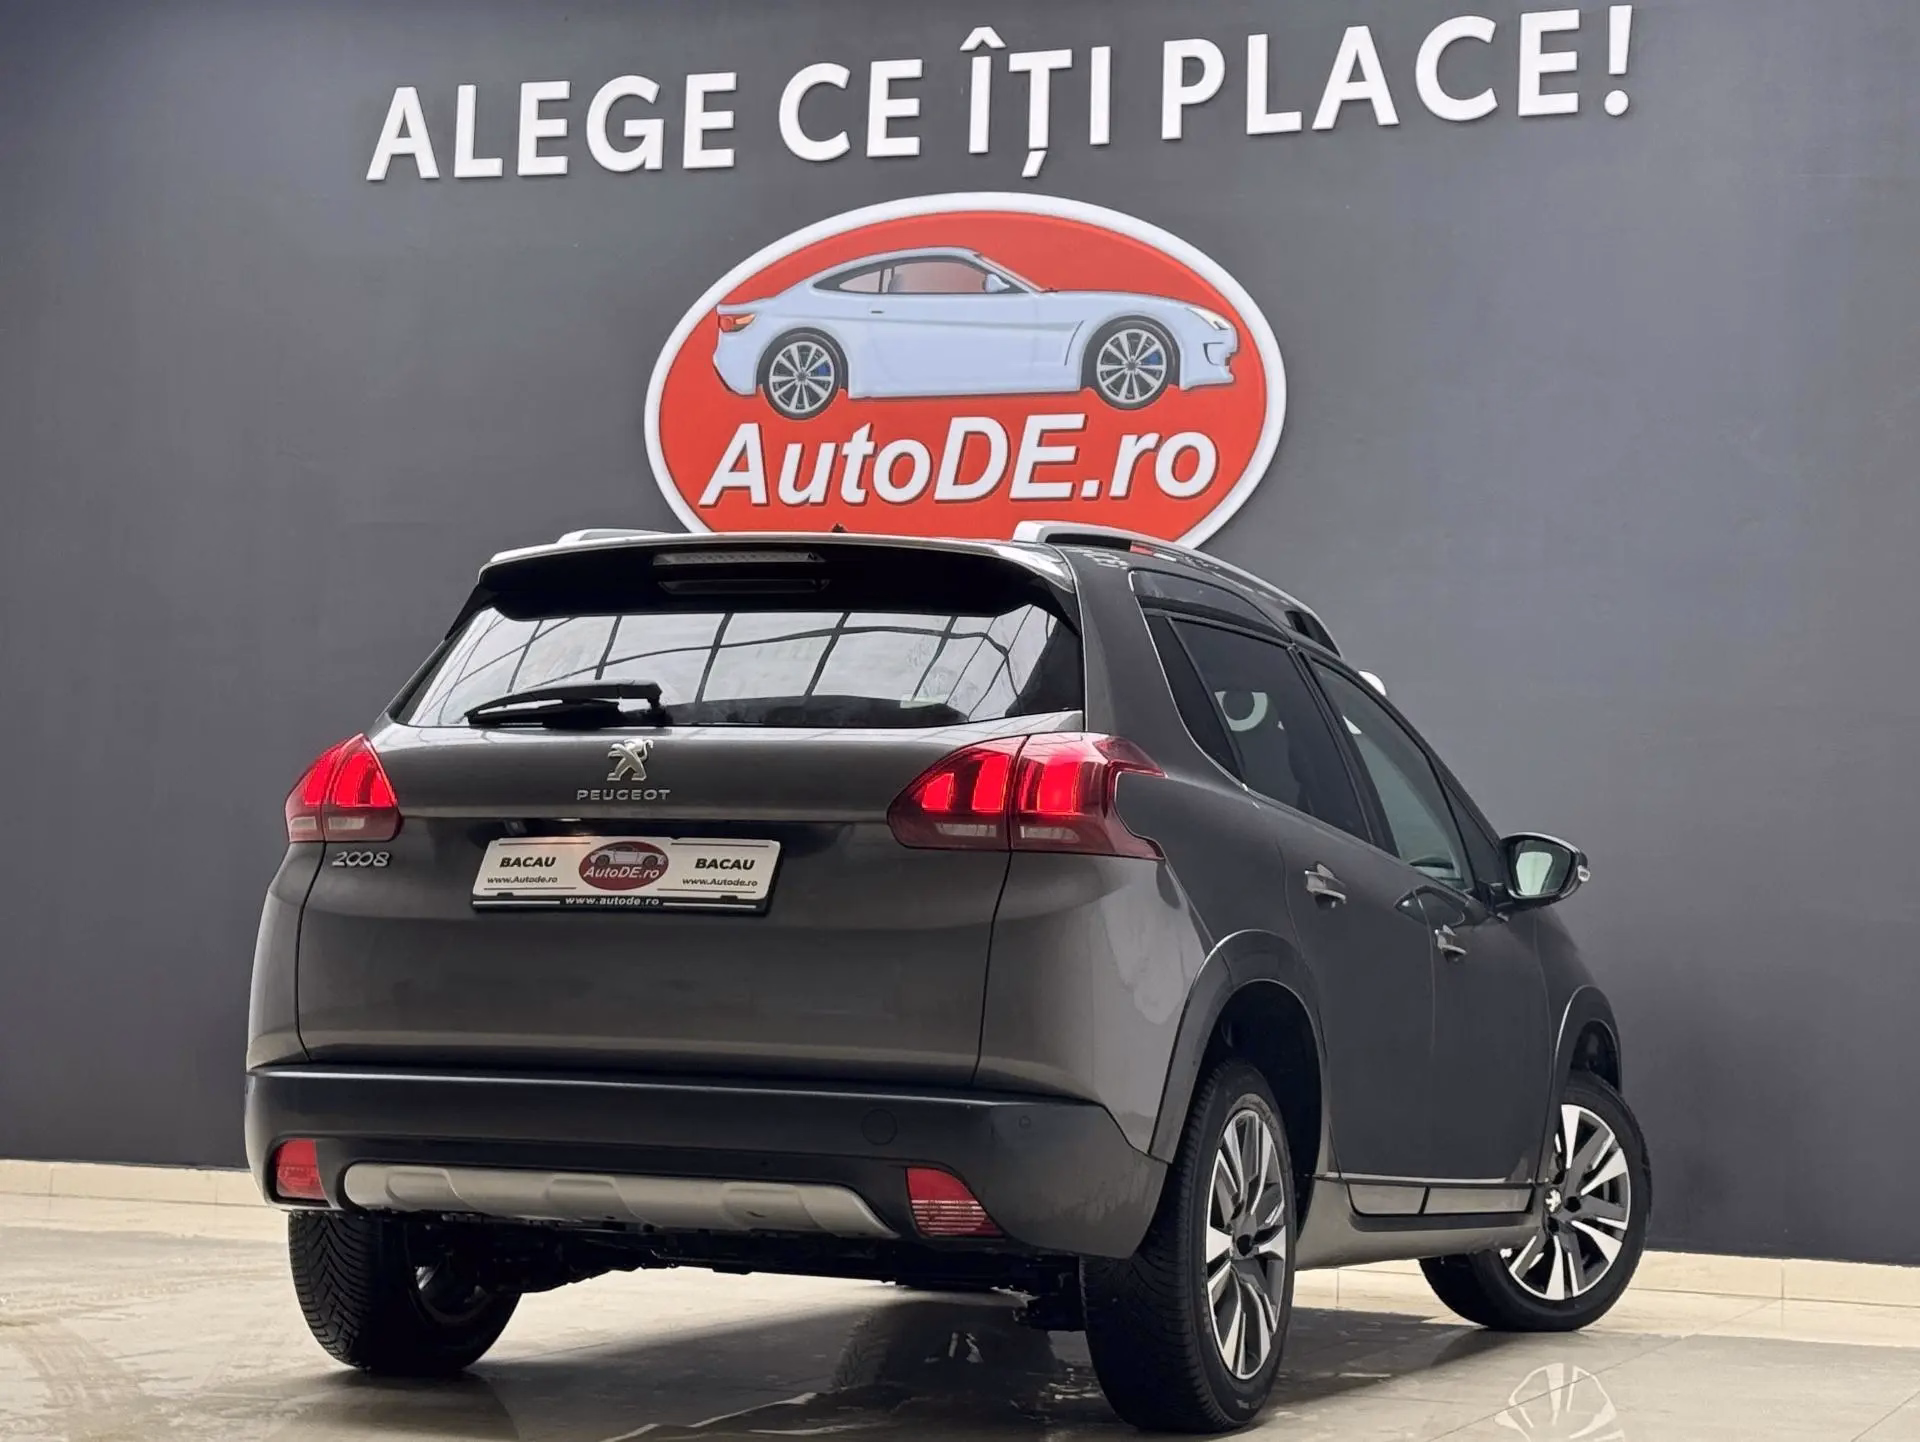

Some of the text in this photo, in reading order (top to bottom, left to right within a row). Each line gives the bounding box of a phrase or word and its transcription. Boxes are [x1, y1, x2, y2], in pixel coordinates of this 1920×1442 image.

[365, 71, 737, 181] ALEGE
[778, 60, 922, 161] CE
[1161, 5, 1633, 141] PLACE!
[698, 412, 1218, 506] AutoDE.ro
[576, 789, 671, 801] PEUGEOT
[331, 851, 391, 868] 2008
[499, 856, 557, 868] BACAU
[694, 857, 755, 870] BACAU
[582, 866, 661, 880] AutoDE.ro
[486, 875, 558, 884] www.Autode.ro
[681, 876, 758, 887] www.Autode.ro
[564, 896, 660, 906] www.autode.ro
